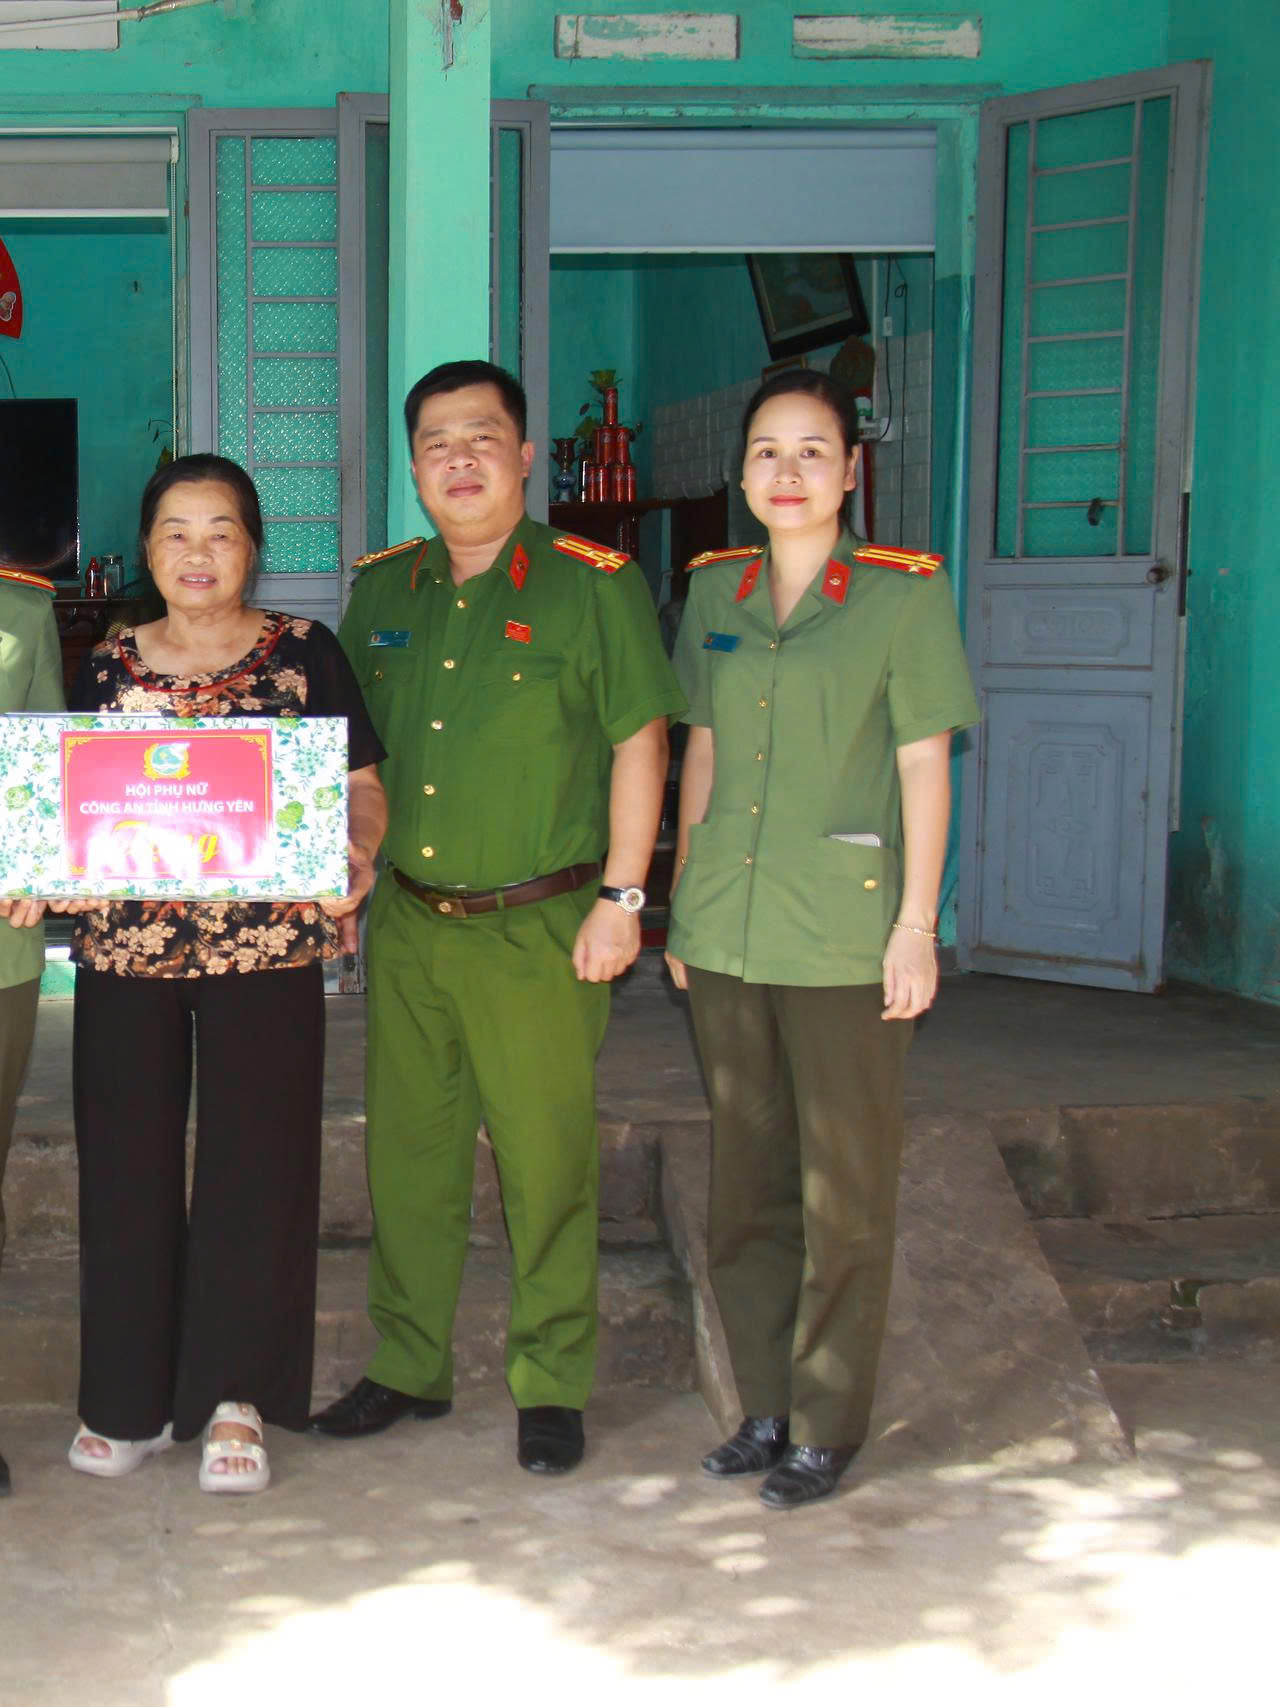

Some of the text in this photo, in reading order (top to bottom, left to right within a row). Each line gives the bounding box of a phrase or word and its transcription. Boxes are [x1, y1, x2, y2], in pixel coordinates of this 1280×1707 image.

[125, 782, 209, 798] HỘI PHỤ NỮ
[79, 801, 120, 814] CÔNG
[123, 803, 144, 814] AN
[181, 801, 224, 813] HƯNG
[226, 799, 254, 812] YÊN
